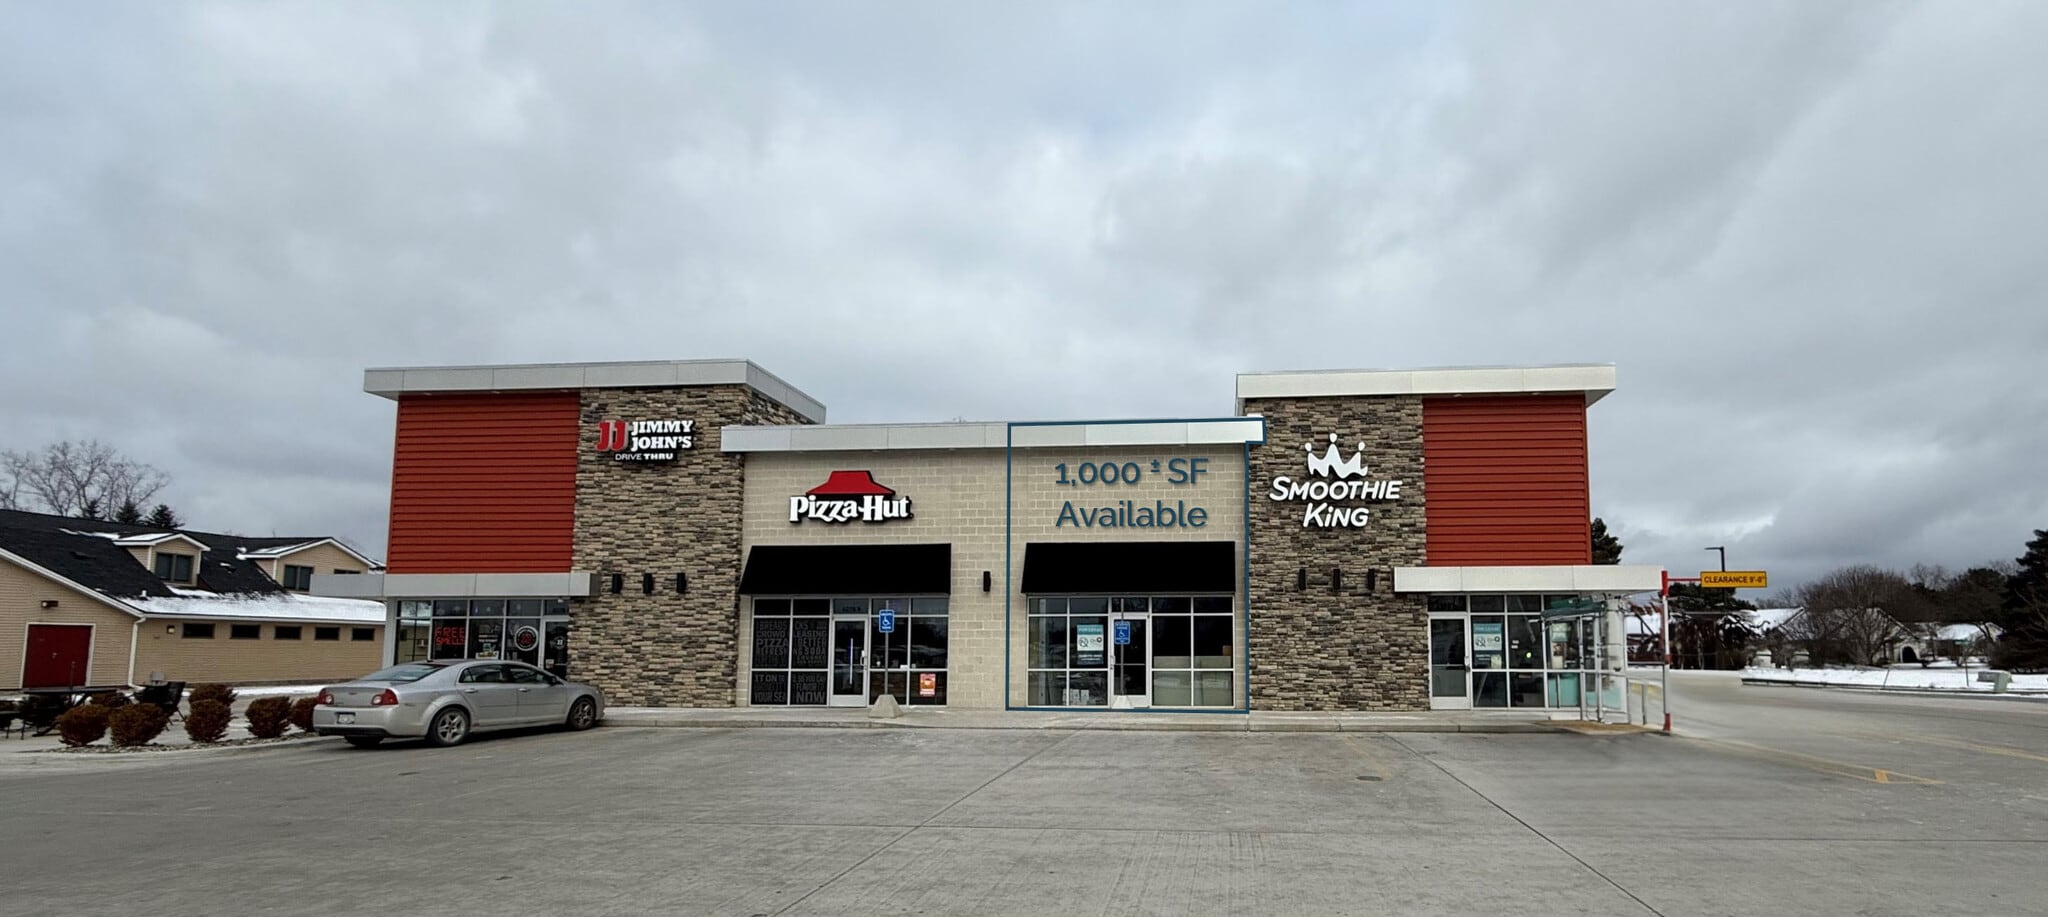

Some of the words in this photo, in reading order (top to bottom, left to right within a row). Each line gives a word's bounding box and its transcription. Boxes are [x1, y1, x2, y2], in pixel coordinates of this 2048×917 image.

[631, 420, 693, 436] JIMMY
[631, 436, 692, 452] JOHN'S
[615, 453, 642, 461] DRIVE
[1269, 476, 1403, 501] SMOOTHIE
[789, 495, 858, 522] Pizza
[858, 495, 909, 521] Hut
[1704, 575, 1749, 584] CLEARANCE
[435, 626, 465, 638] FREE
[756, 638, 788, 648] PIZZA
[796, 691, 825, 703] NOW
